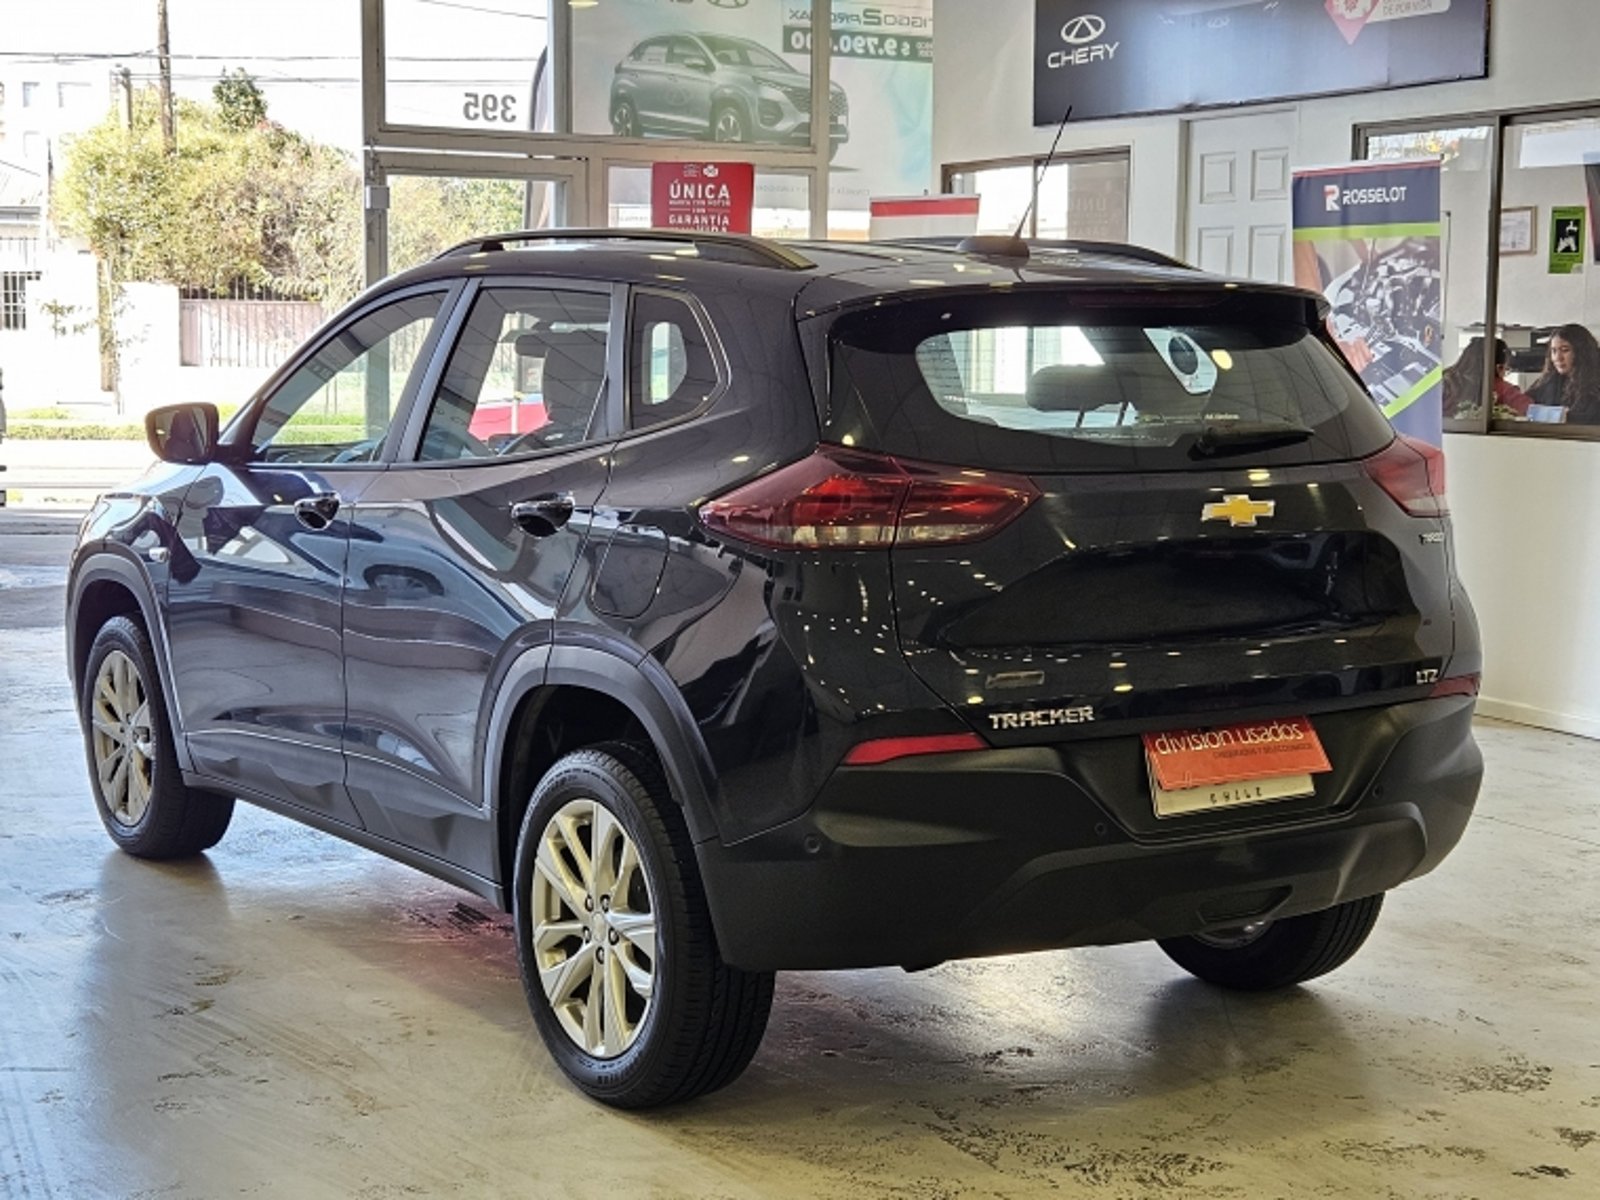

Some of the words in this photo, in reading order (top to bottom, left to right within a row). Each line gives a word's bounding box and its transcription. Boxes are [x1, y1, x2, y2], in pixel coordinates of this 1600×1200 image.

[1047, 41, 1120, 68] CHERY
[669, 179, 730, 199] ÚNICA
[1342, 186, 1407, 205] ROSSELOT
[1416, 669, 1438, 684] LTZ
[988, 705, 1095, 729] TRACKER
[1155, 729, 1235, 755] division
[1237, 721, 1304, 745] usados
